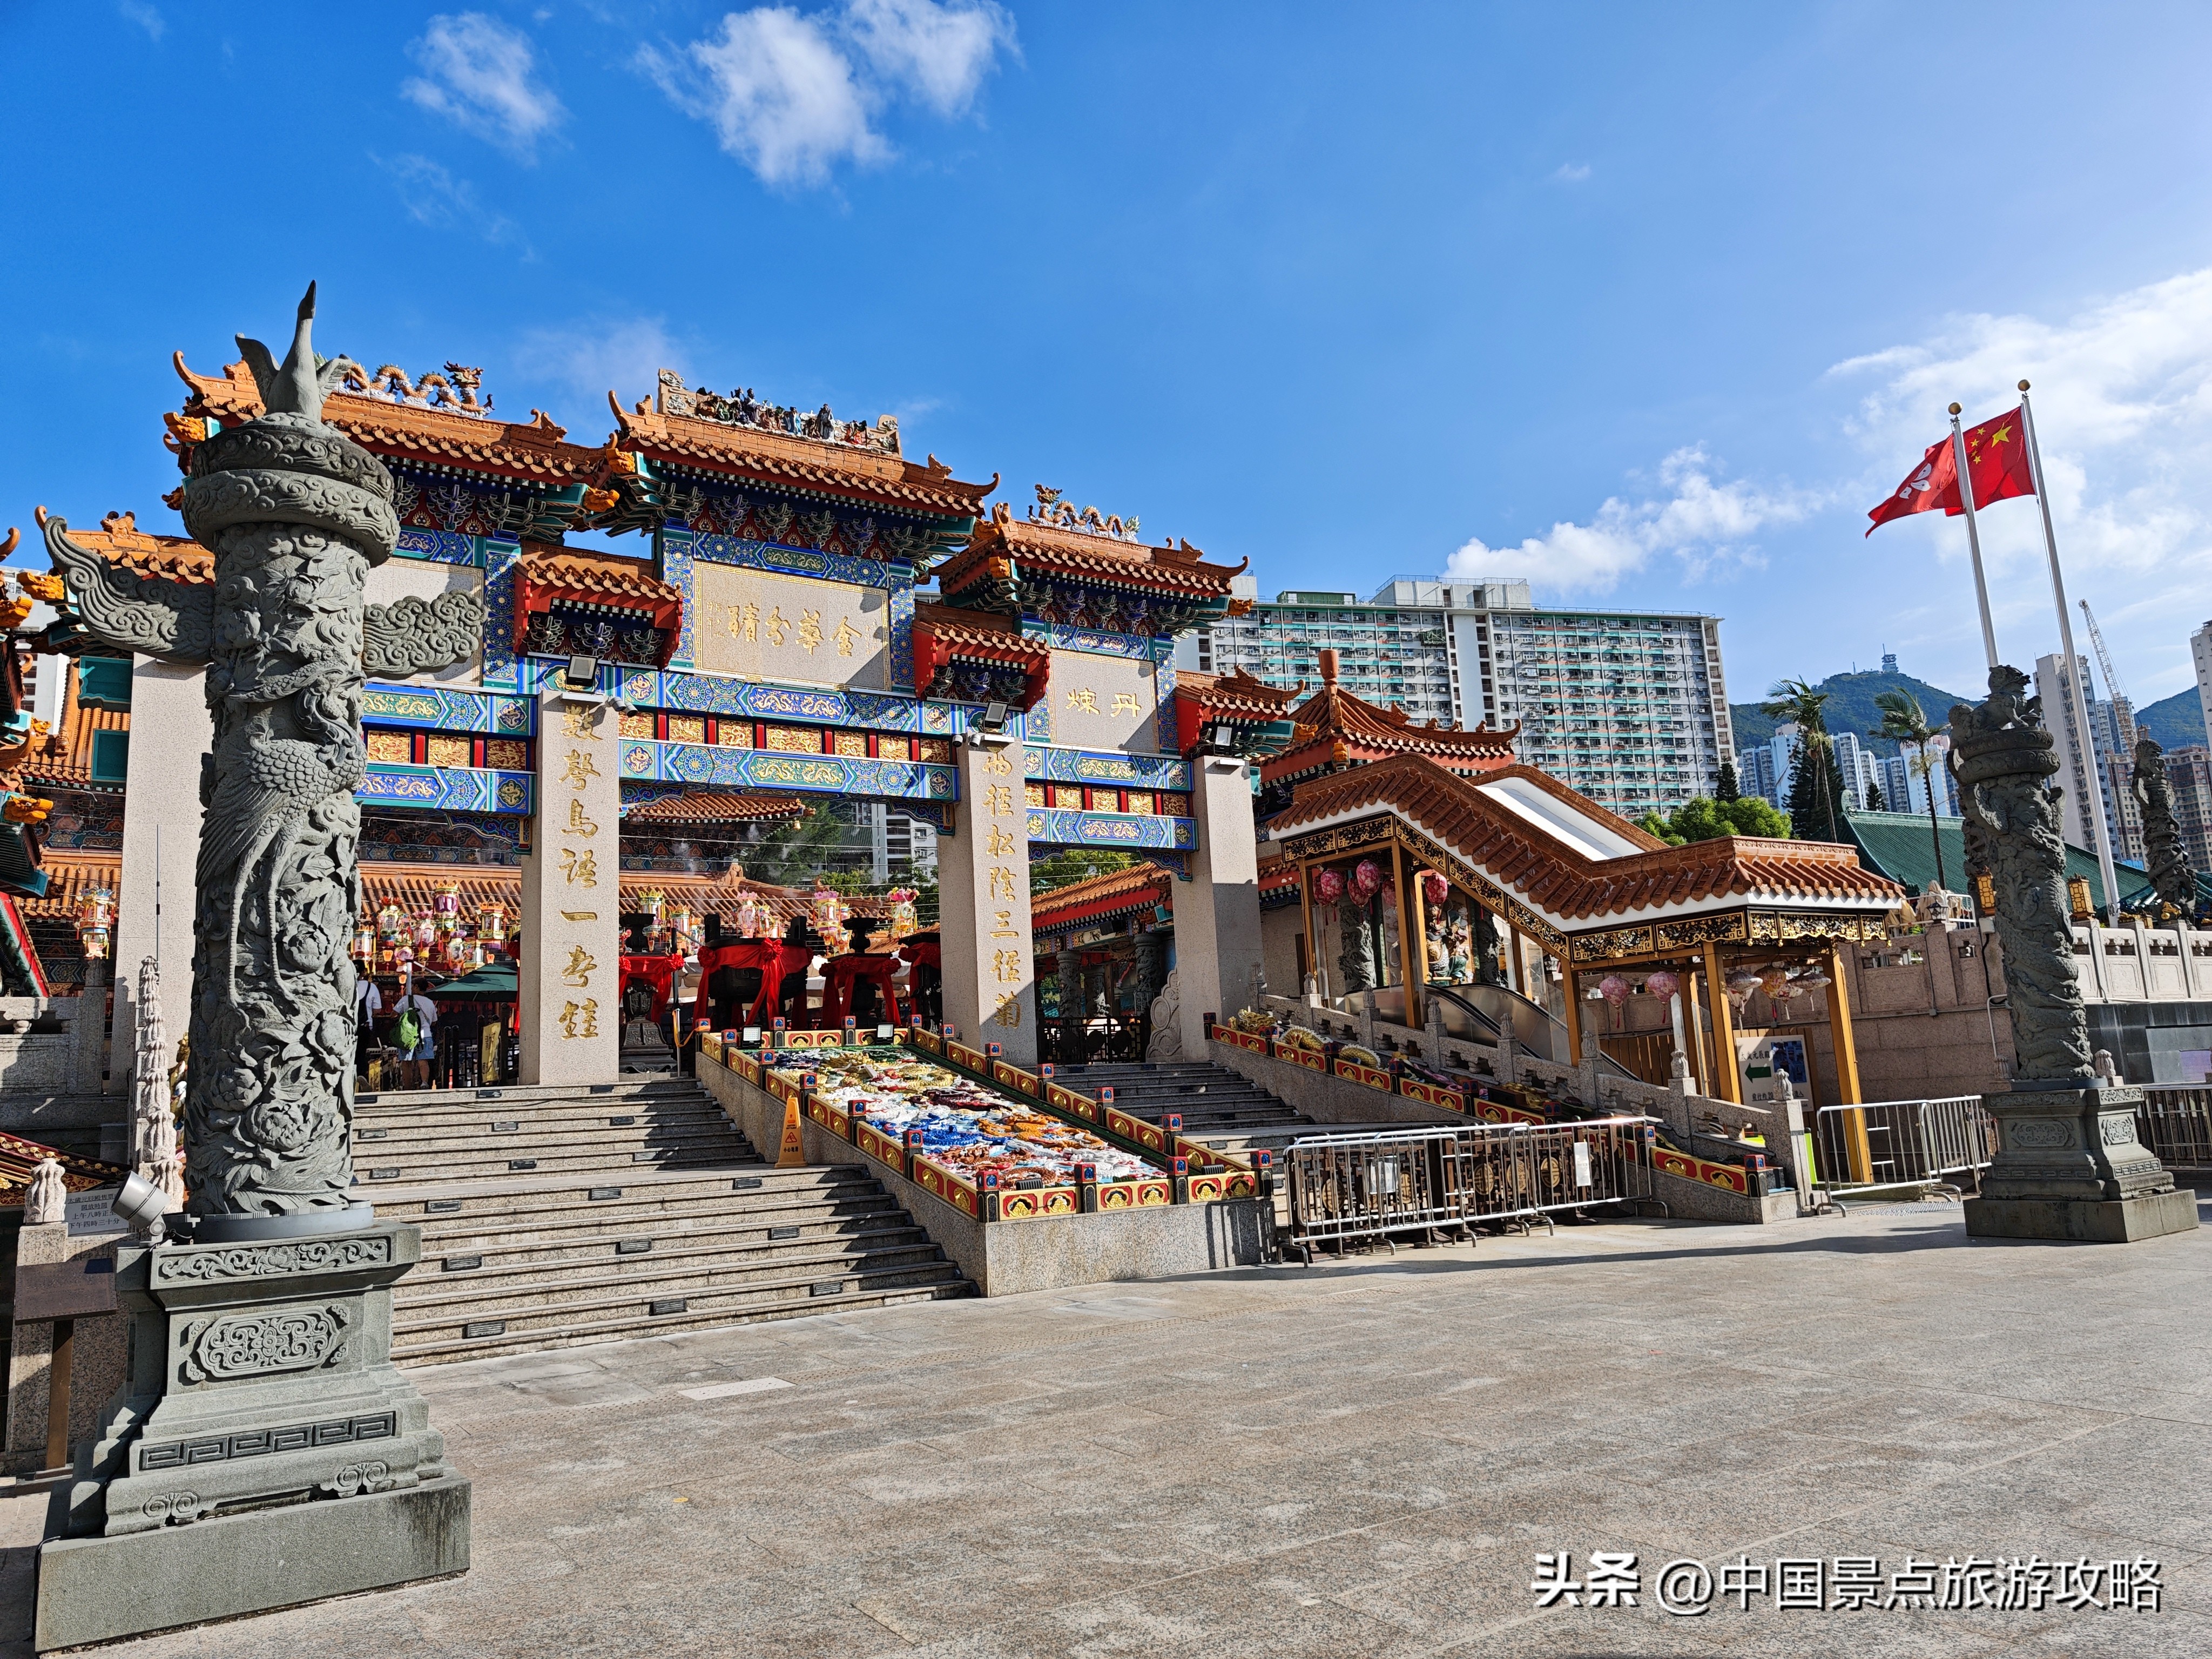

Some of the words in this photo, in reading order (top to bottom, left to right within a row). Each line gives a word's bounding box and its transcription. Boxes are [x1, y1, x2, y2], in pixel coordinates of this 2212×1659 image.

[81, 1202, 107, 1210] 開放時間
[69, 1217, 120, 1229] 下午四時三十分
